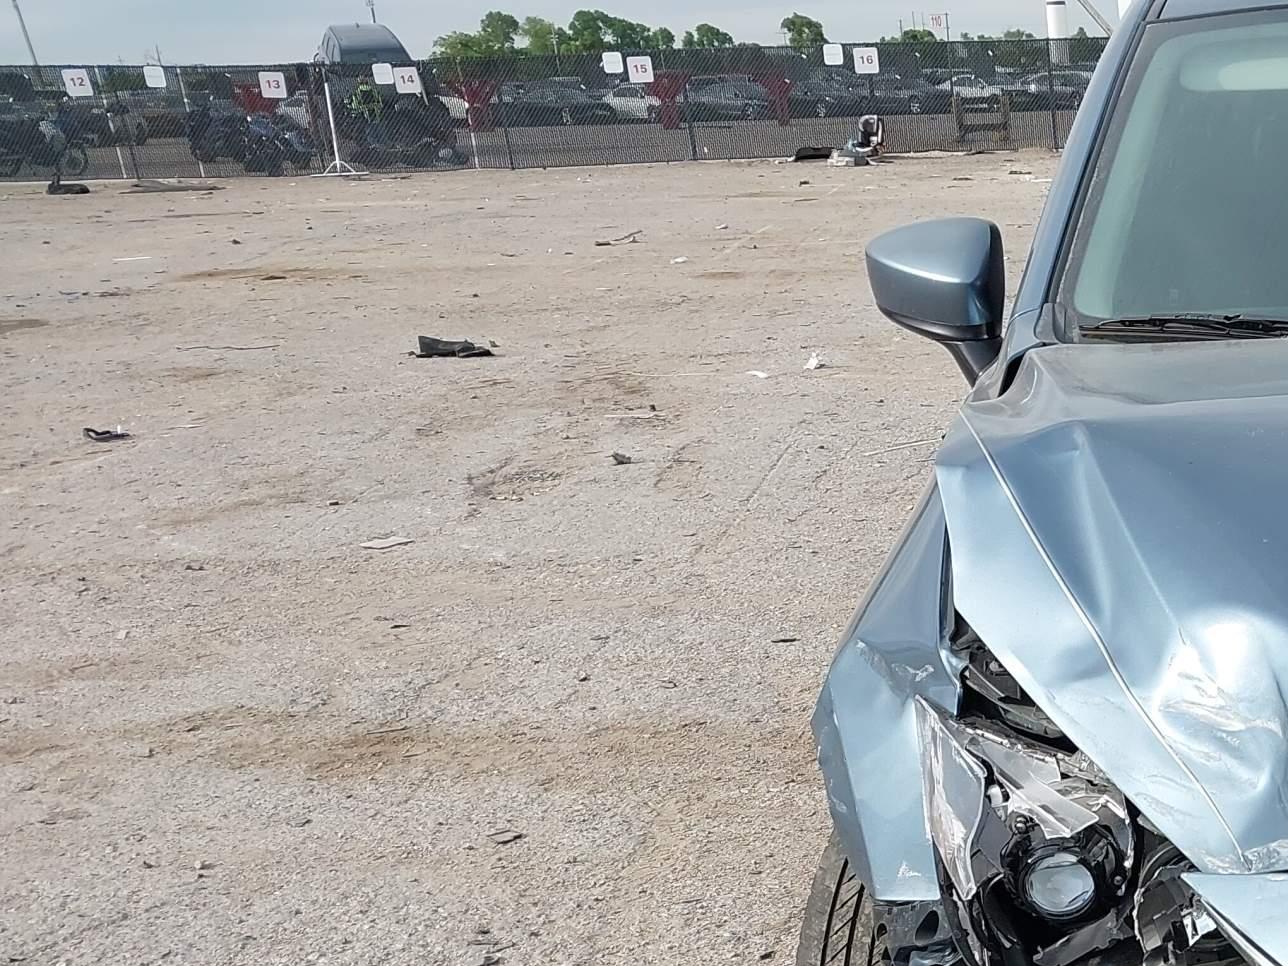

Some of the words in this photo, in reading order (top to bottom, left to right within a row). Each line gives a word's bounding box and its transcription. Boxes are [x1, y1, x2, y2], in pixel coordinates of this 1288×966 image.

[858, 55, 873, 65] 16
[633, 64, 648, 74] 15
[70, 77, 86, 87] 12
[265, 80, 281, 89] 13
[400, 75, 415, 85] 14
